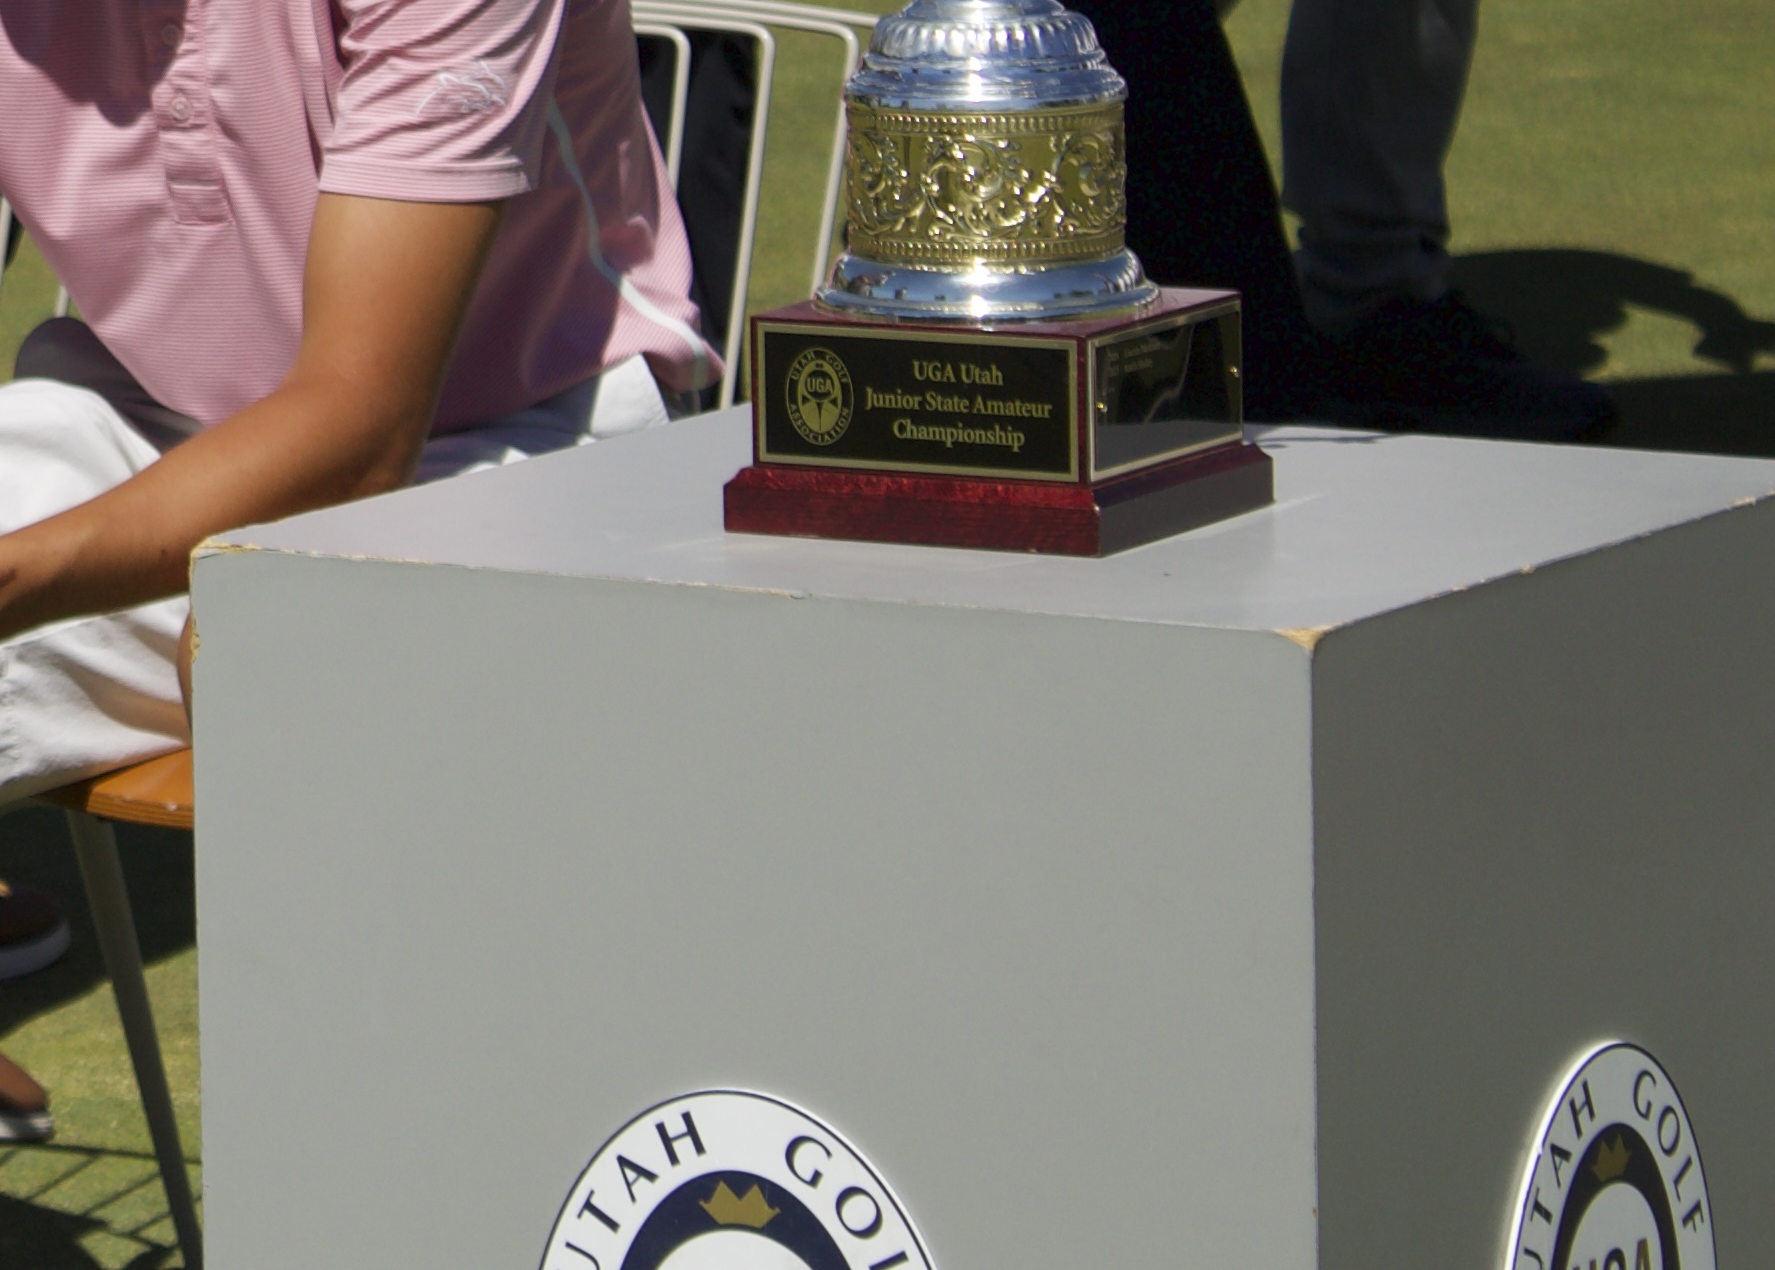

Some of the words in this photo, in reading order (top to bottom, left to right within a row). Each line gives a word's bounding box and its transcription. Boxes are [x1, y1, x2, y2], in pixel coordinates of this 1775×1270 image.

[791, 351, 816, 380] UTAH
[826, 355, 849, 383] GOLF
[913, 359, 957, 384] UGA
[958, 362, 1005, 387] Utah
[806, 376, 834, 394] UGA
[865, 386, 923, 410] Junior
[925, 391, 970, 414] State
[972, 395, 1054, 419] Amateur
[791, 403, 850, 443] ASSOCIATION
[892, 417, 1026, 453] Championship
[1632, 1068, 1705, 1234] GOLF
